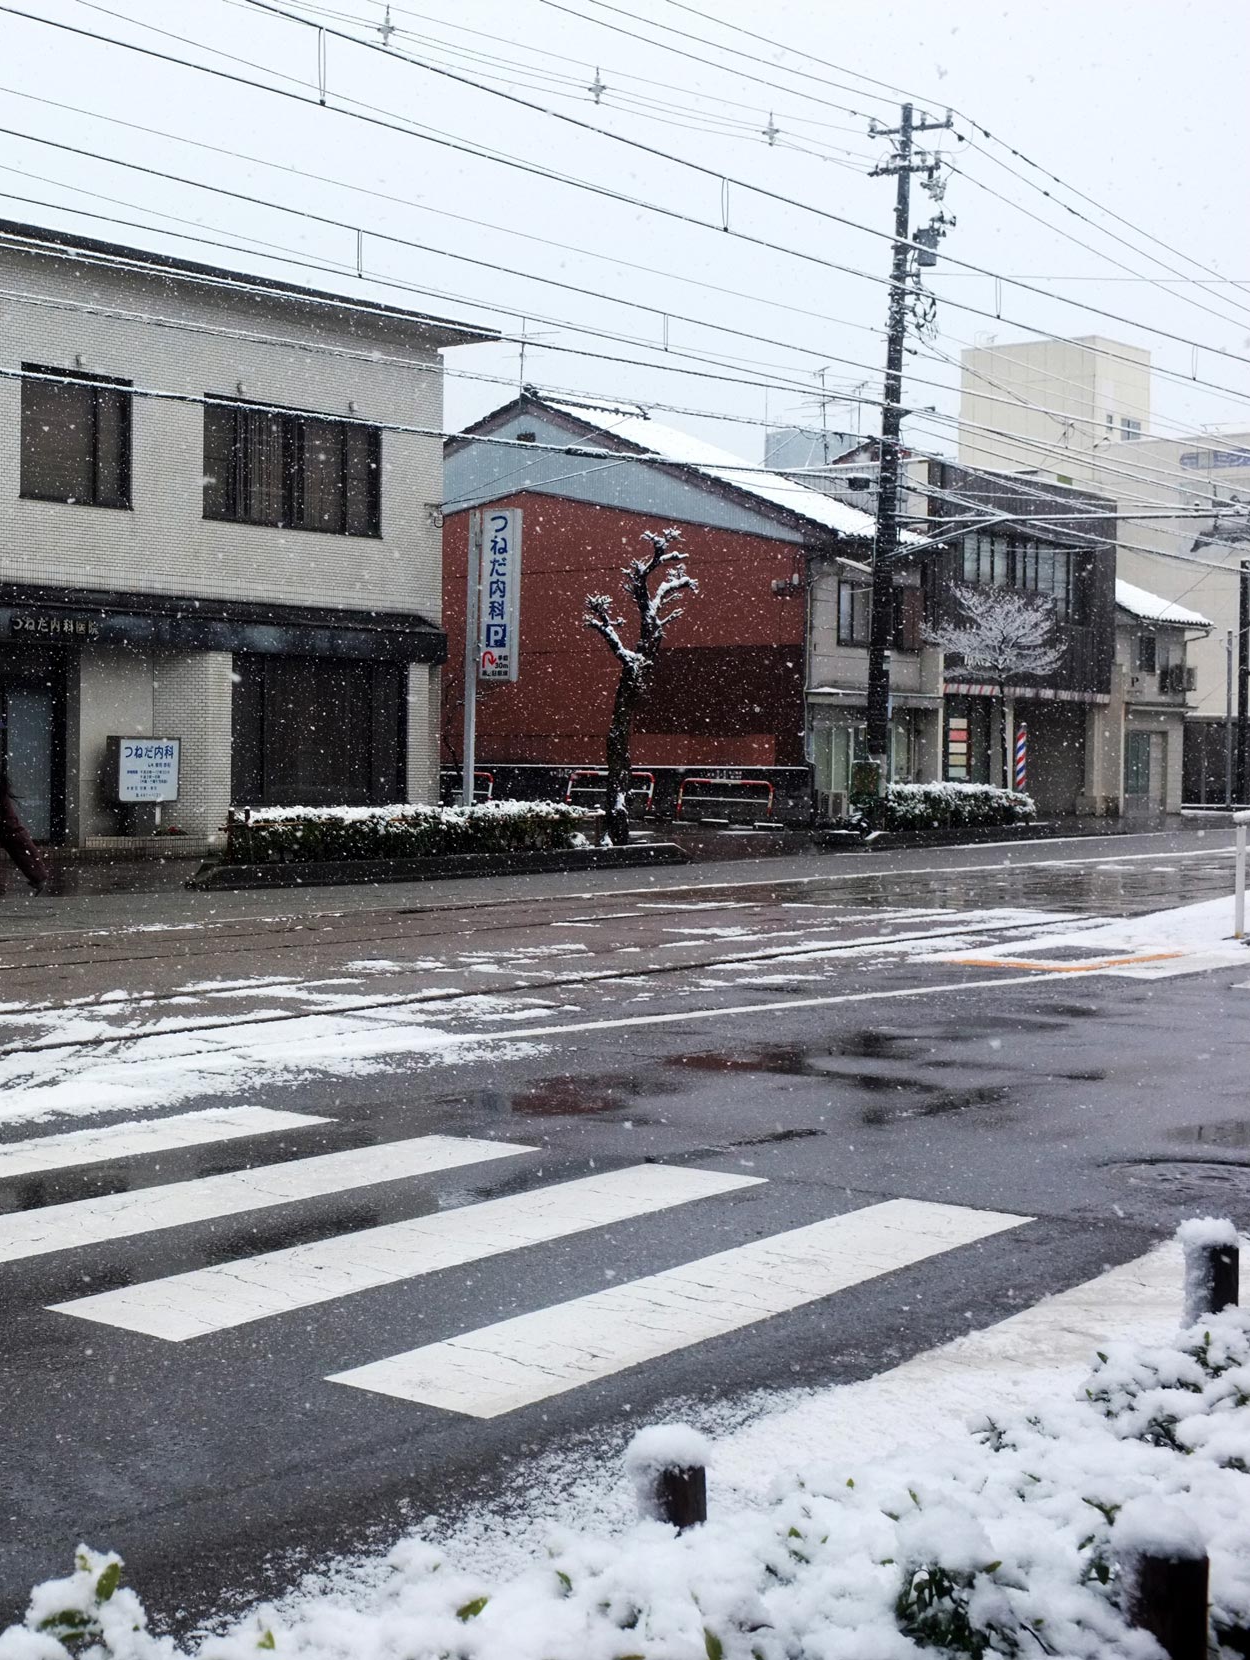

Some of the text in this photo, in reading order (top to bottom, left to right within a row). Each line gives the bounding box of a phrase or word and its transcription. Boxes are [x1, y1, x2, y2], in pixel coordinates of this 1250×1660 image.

[488, 515, 508, 620] つねだ内科
[13, 616, 99, 634] つねだ内科医院
[125, 745, 174, 759] つねだ内科
